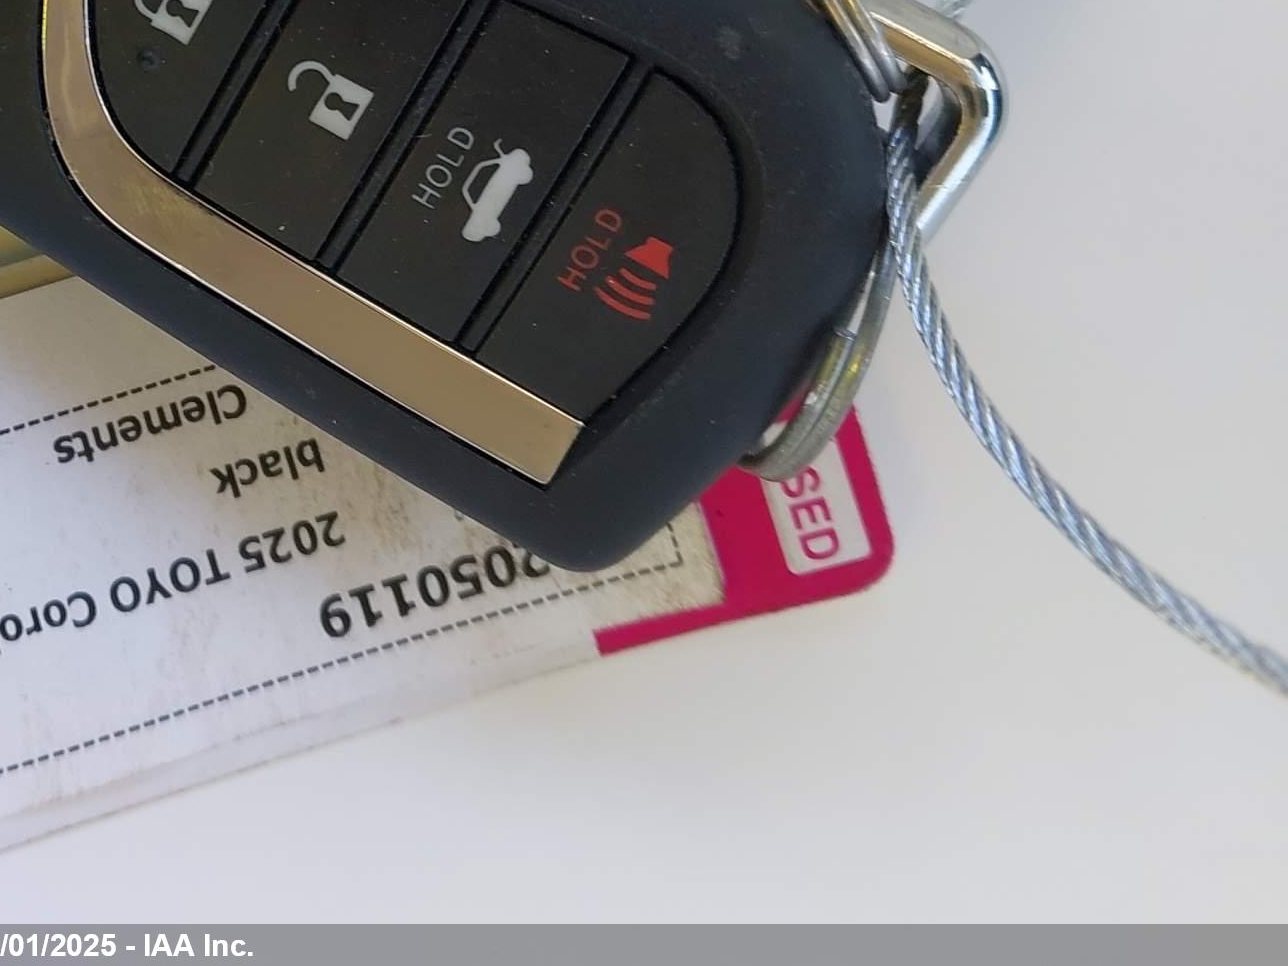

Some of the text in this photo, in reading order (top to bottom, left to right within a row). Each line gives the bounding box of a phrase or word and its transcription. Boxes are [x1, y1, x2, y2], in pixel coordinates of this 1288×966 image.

[412, 126, 475, 209] HOLD
[558, 209, 623, 290] HOLD
[53, 384, 249, 462] Clements
[210, 438, 326, 498] black
[238, 511, 347, 573] 2025
[110, 548, 231, 613] TOYO
